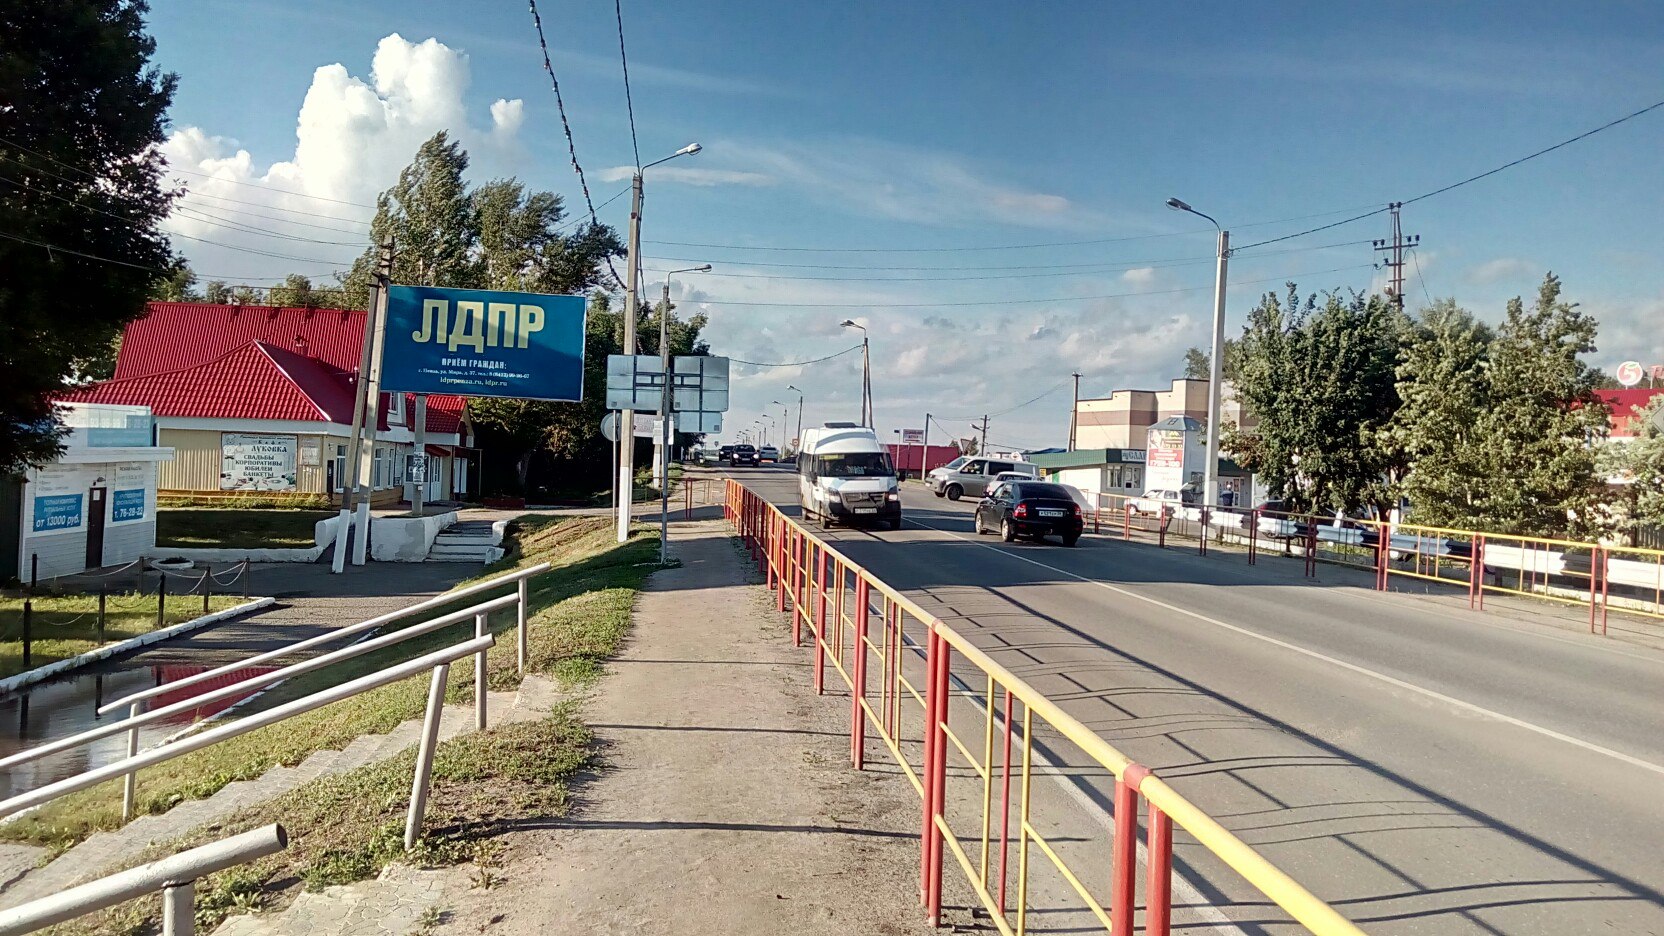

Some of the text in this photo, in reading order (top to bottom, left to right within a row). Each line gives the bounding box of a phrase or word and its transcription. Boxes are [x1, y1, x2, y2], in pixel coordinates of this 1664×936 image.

[412, 299, 545, 353] ЛДПР
[441, 357, 507, 370] ПРИЁМ ГРАЖДАН:
[251, 445, 287, 453] ЛУКОВКА
[235, 459, 282, 467] КОРПОРАТИВЫ
[36, 519, 45, 527] от
[47, 515, 66, 526] 13000
